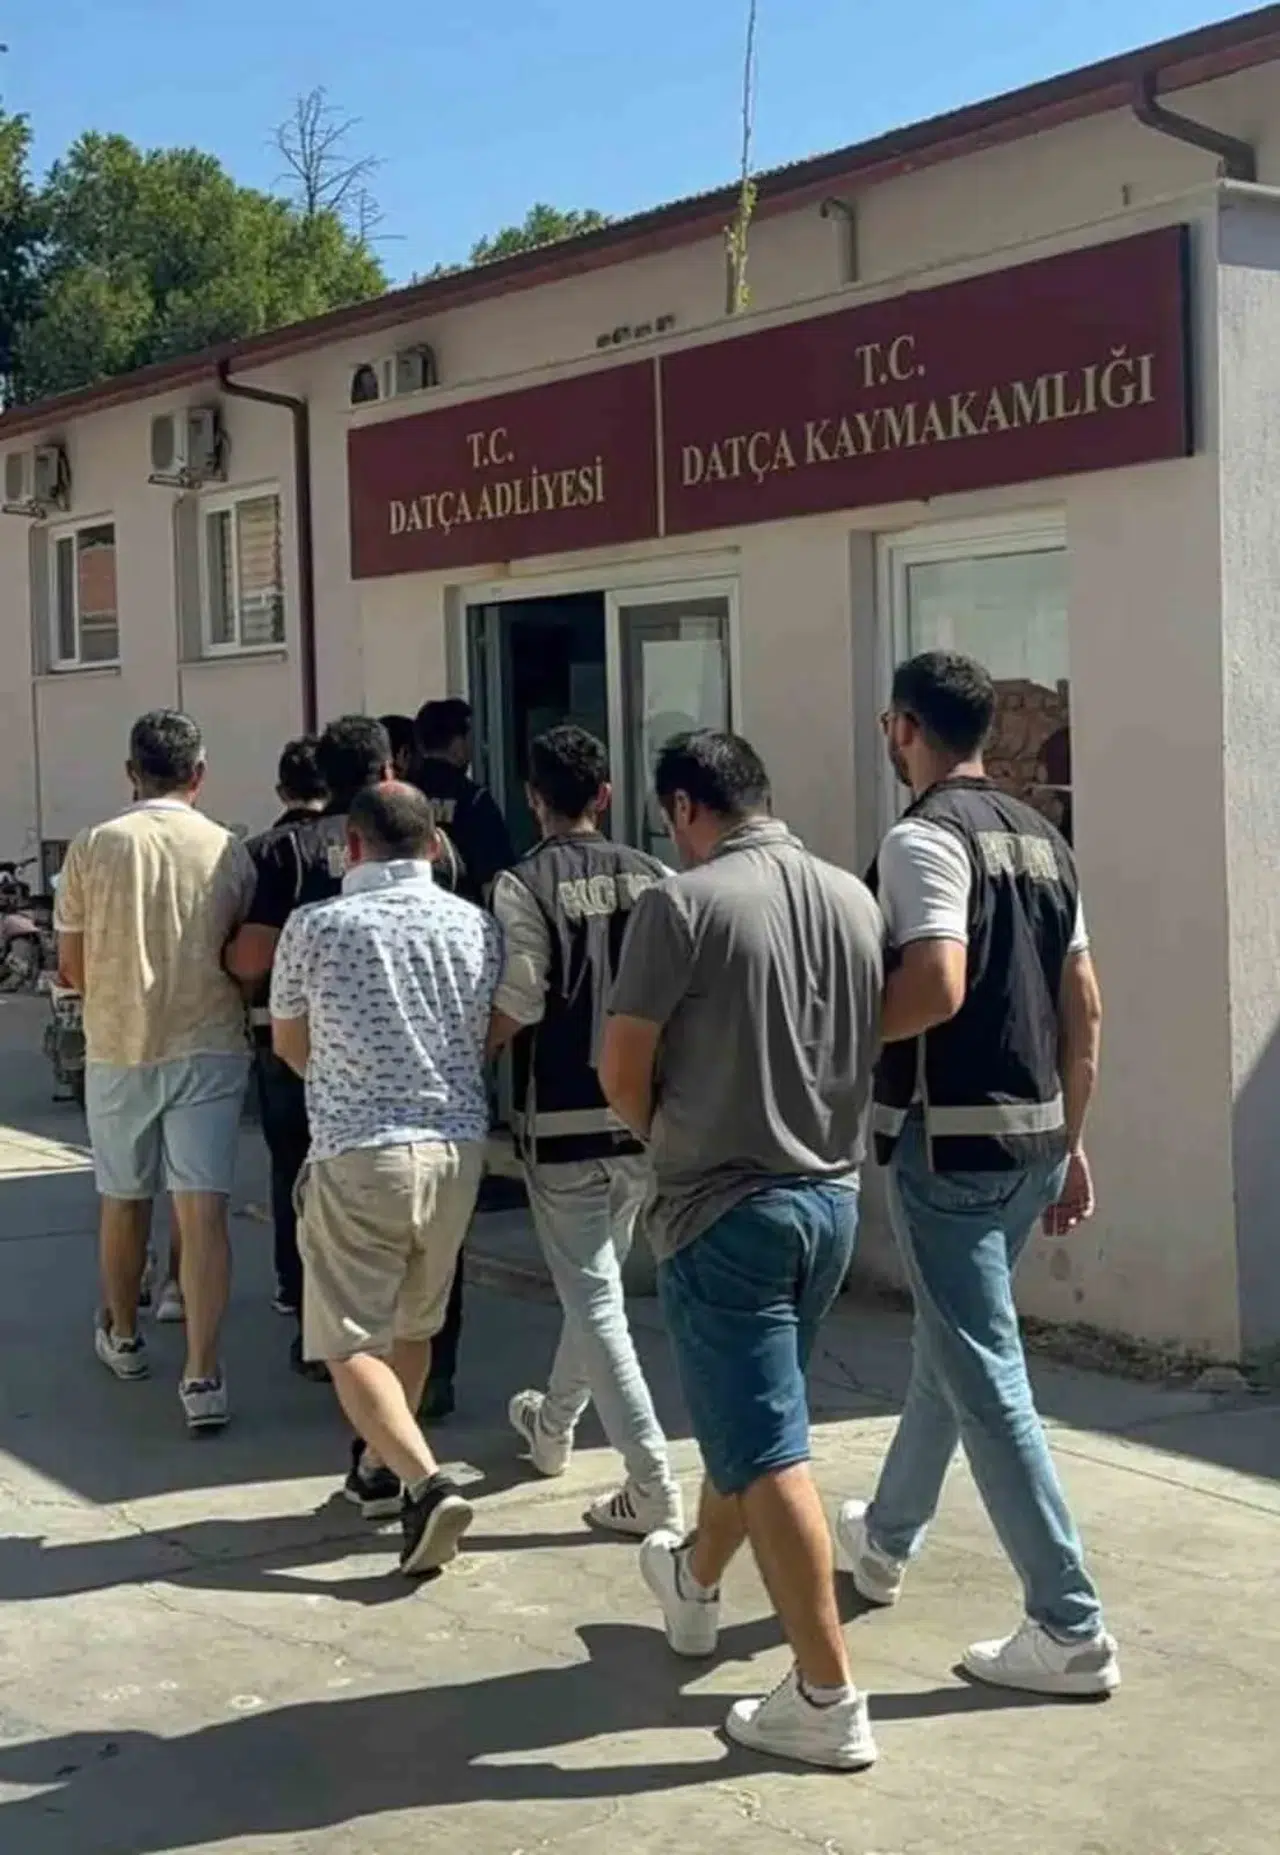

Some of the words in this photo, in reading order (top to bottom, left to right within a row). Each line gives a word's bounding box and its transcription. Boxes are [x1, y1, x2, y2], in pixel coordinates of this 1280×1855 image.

[855, 334, 926, 388] T.C.
[466, 426, 515, 469] T.C.
[681, 430, 796, 486] DATÇA
[804, 344, 1155, 465] KAYMAKAMLIĞI
[389, 489, 473, 536] DATÇA
[475, 455, 605, 520] ADLİYESİ
